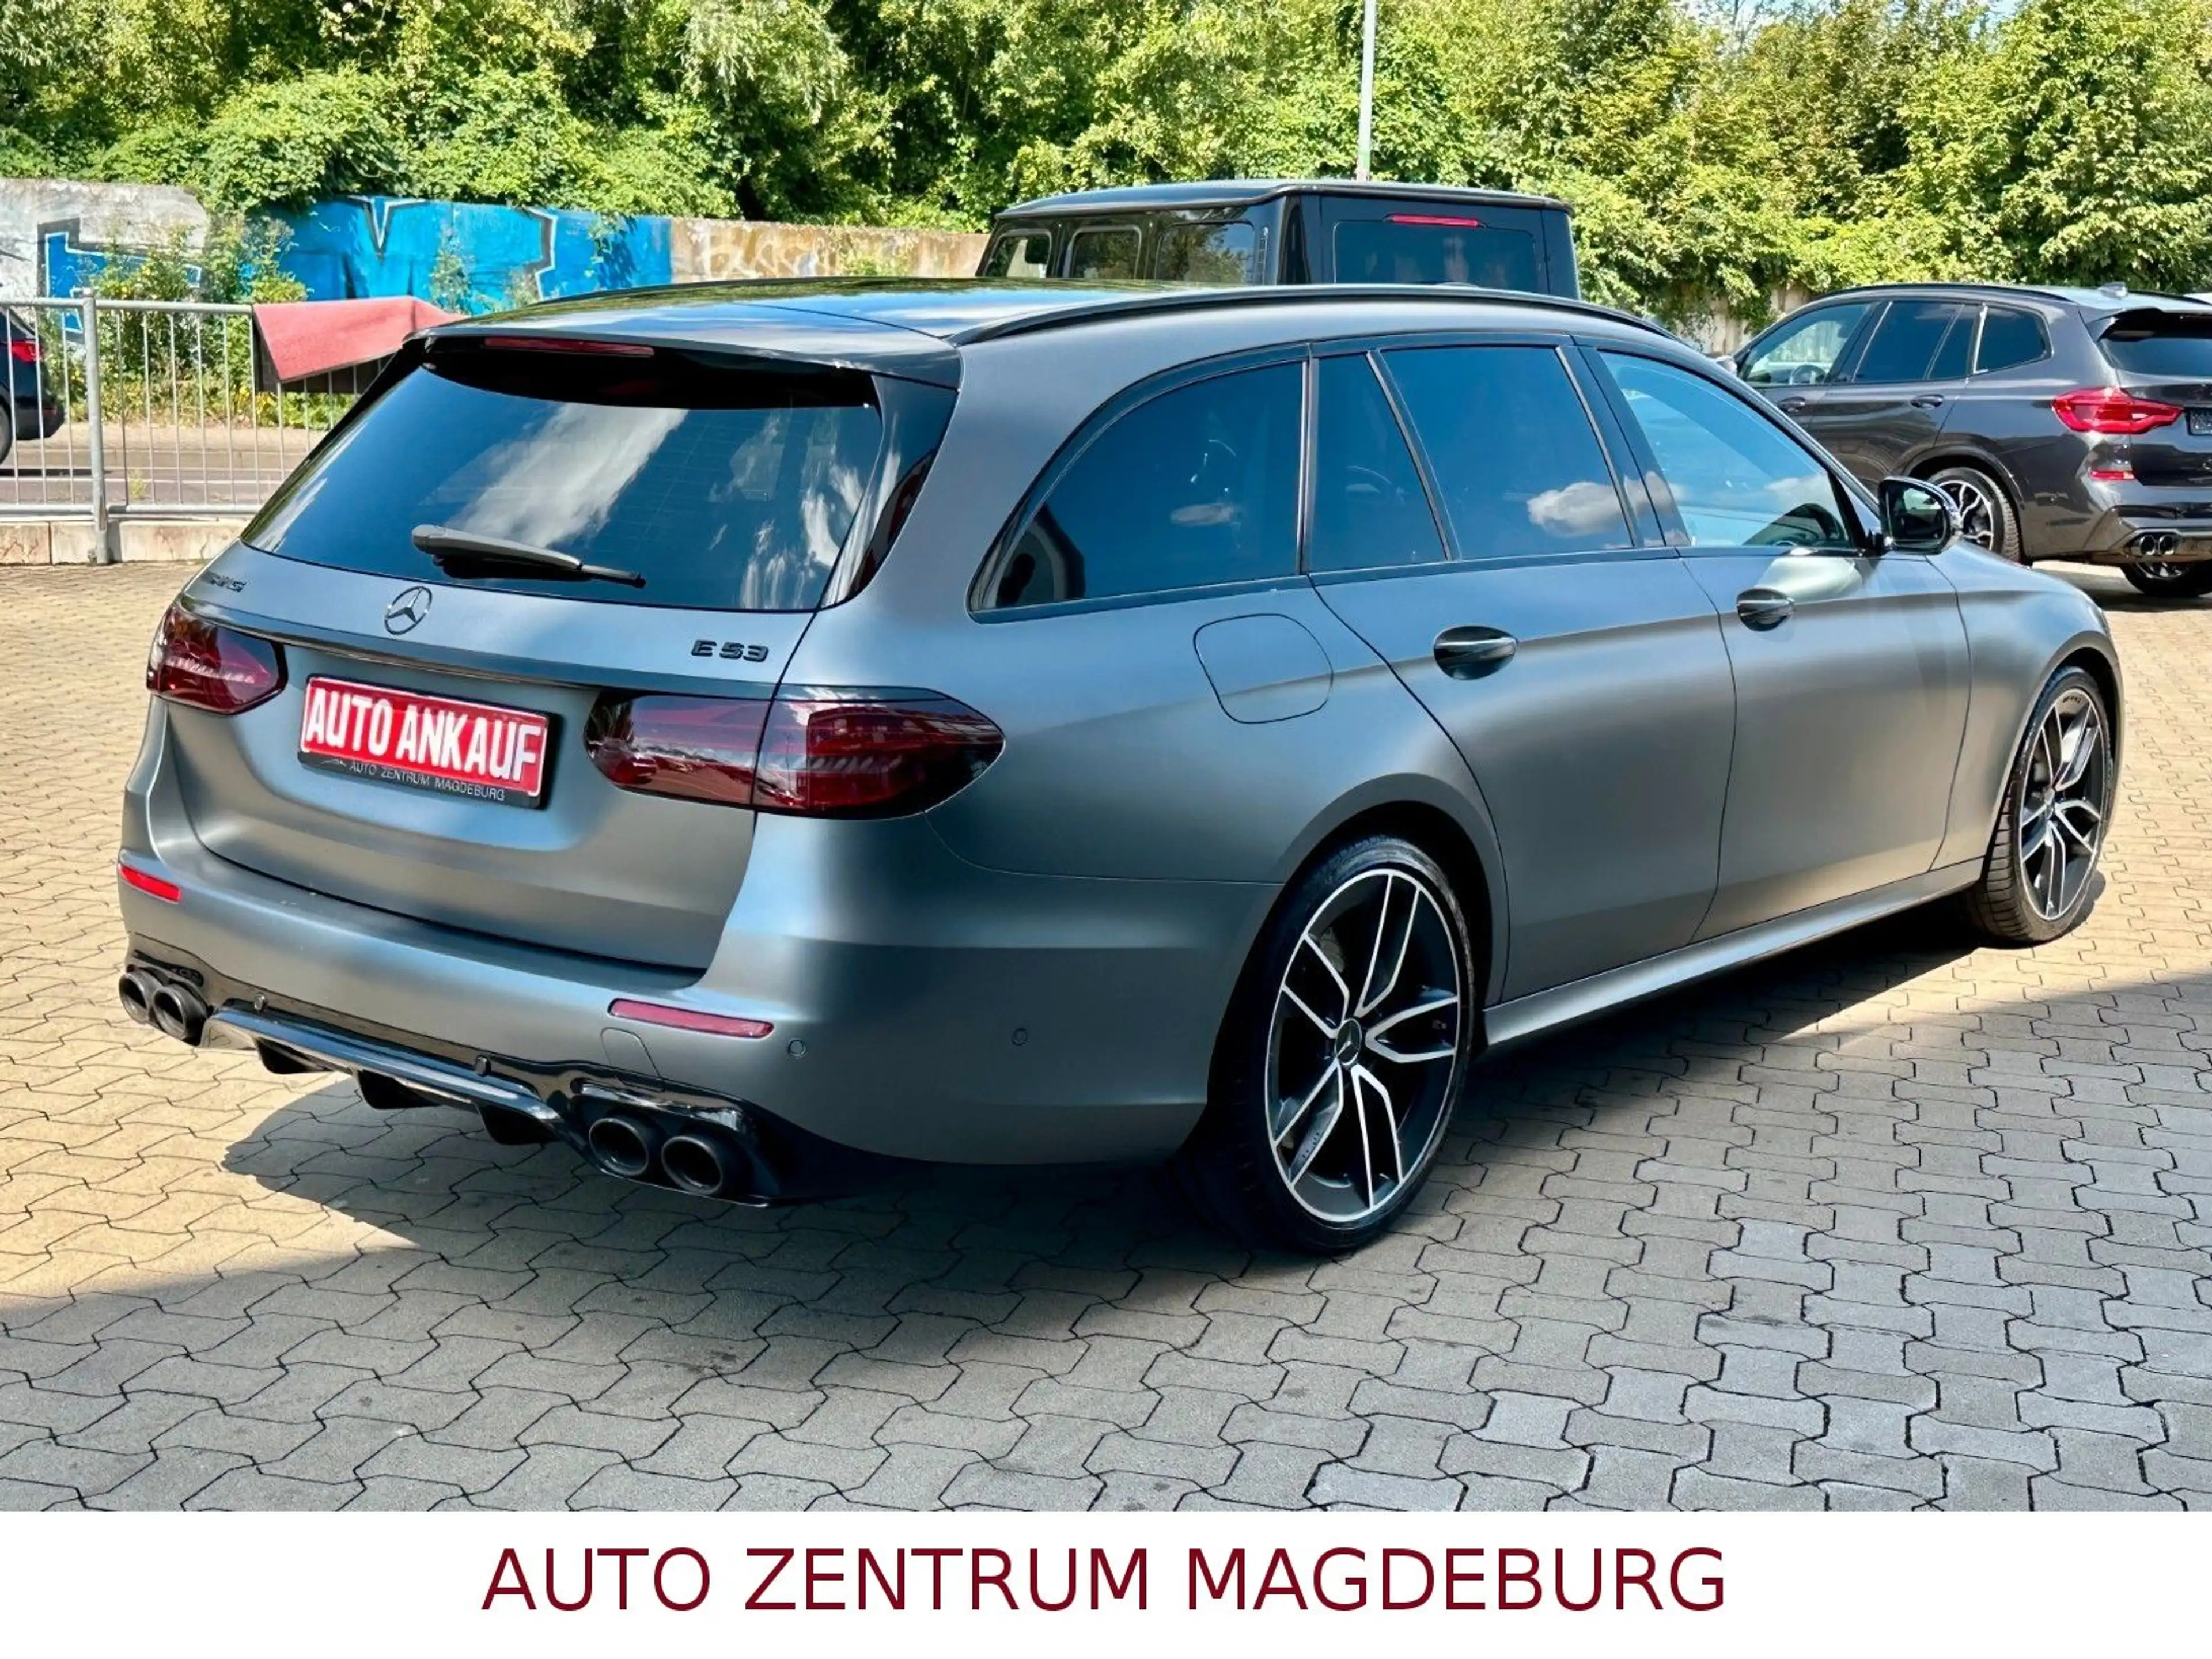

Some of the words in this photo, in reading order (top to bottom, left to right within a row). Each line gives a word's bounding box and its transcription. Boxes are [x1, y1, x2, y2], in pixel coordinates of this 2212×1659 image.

[691, 639, 717, 657] E
[719, 642, 769, 662] 53
[306, 688, 393, 756] AUTO
[395, 704, 541, 782] ANKAUF
[350, 760, 377, 775] AUTO
[381, 769, 430, 786] ZENTRUM
[435, 778, 505, 801] MAGDEBURG
